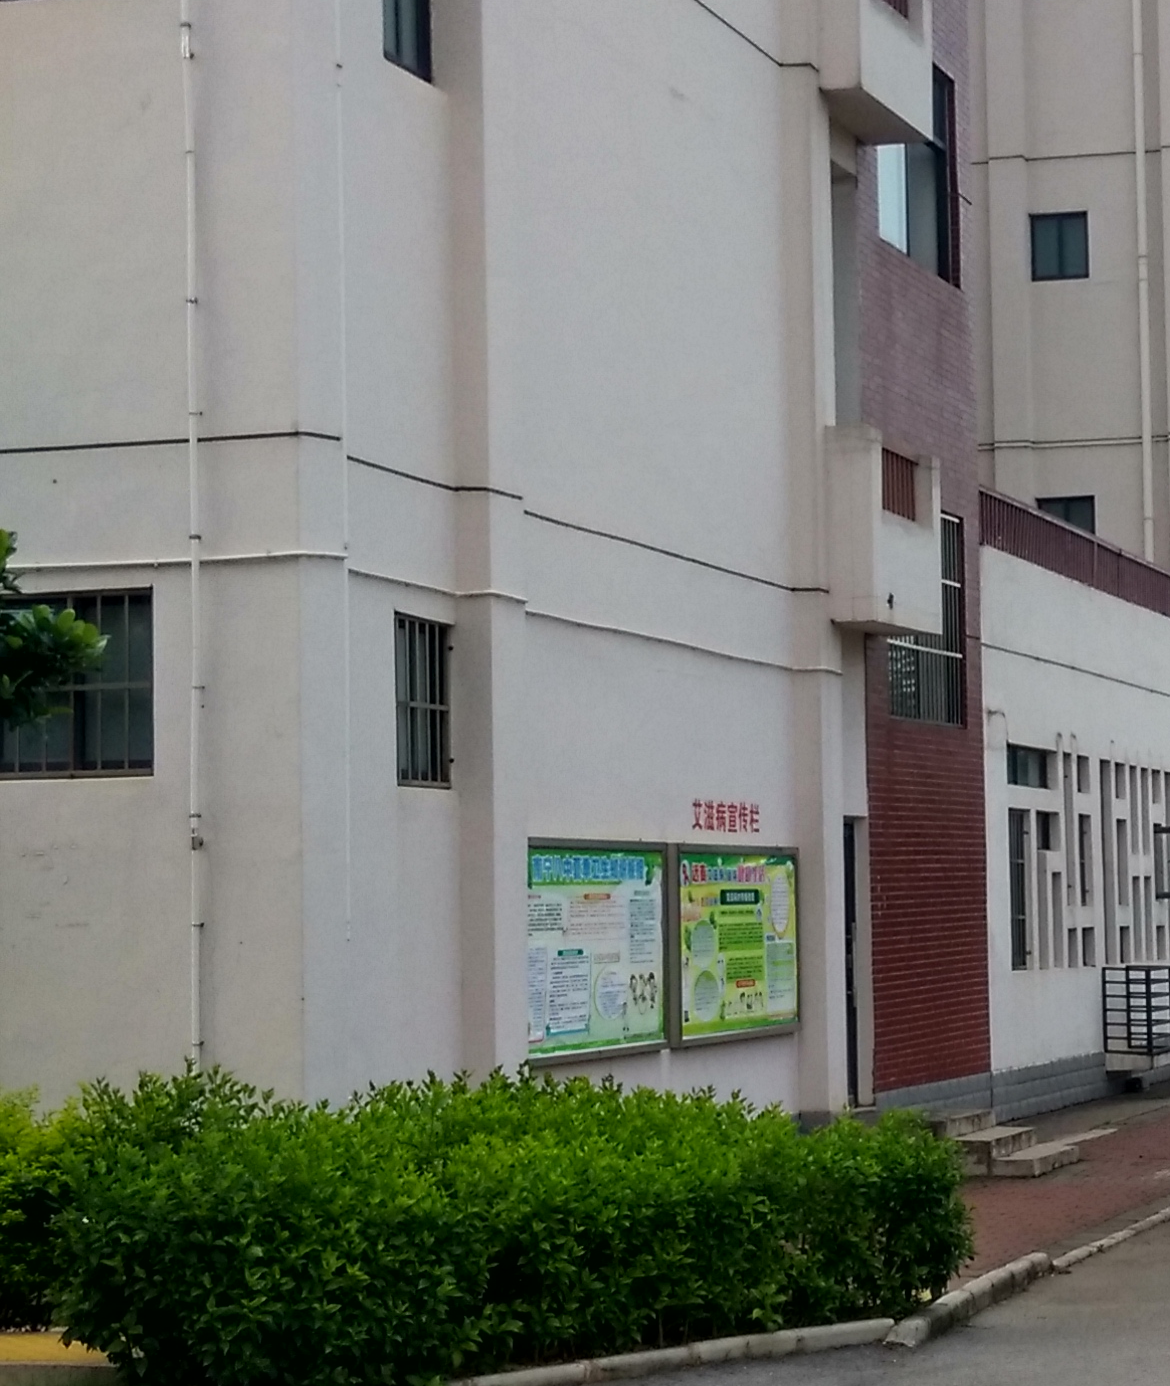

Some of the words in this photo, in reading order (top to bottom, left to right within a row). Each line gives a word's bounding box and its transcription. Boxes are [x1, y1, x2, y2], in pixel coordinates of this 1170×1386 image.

[692, 798, 760, 833] 艾滋病宣传栏
